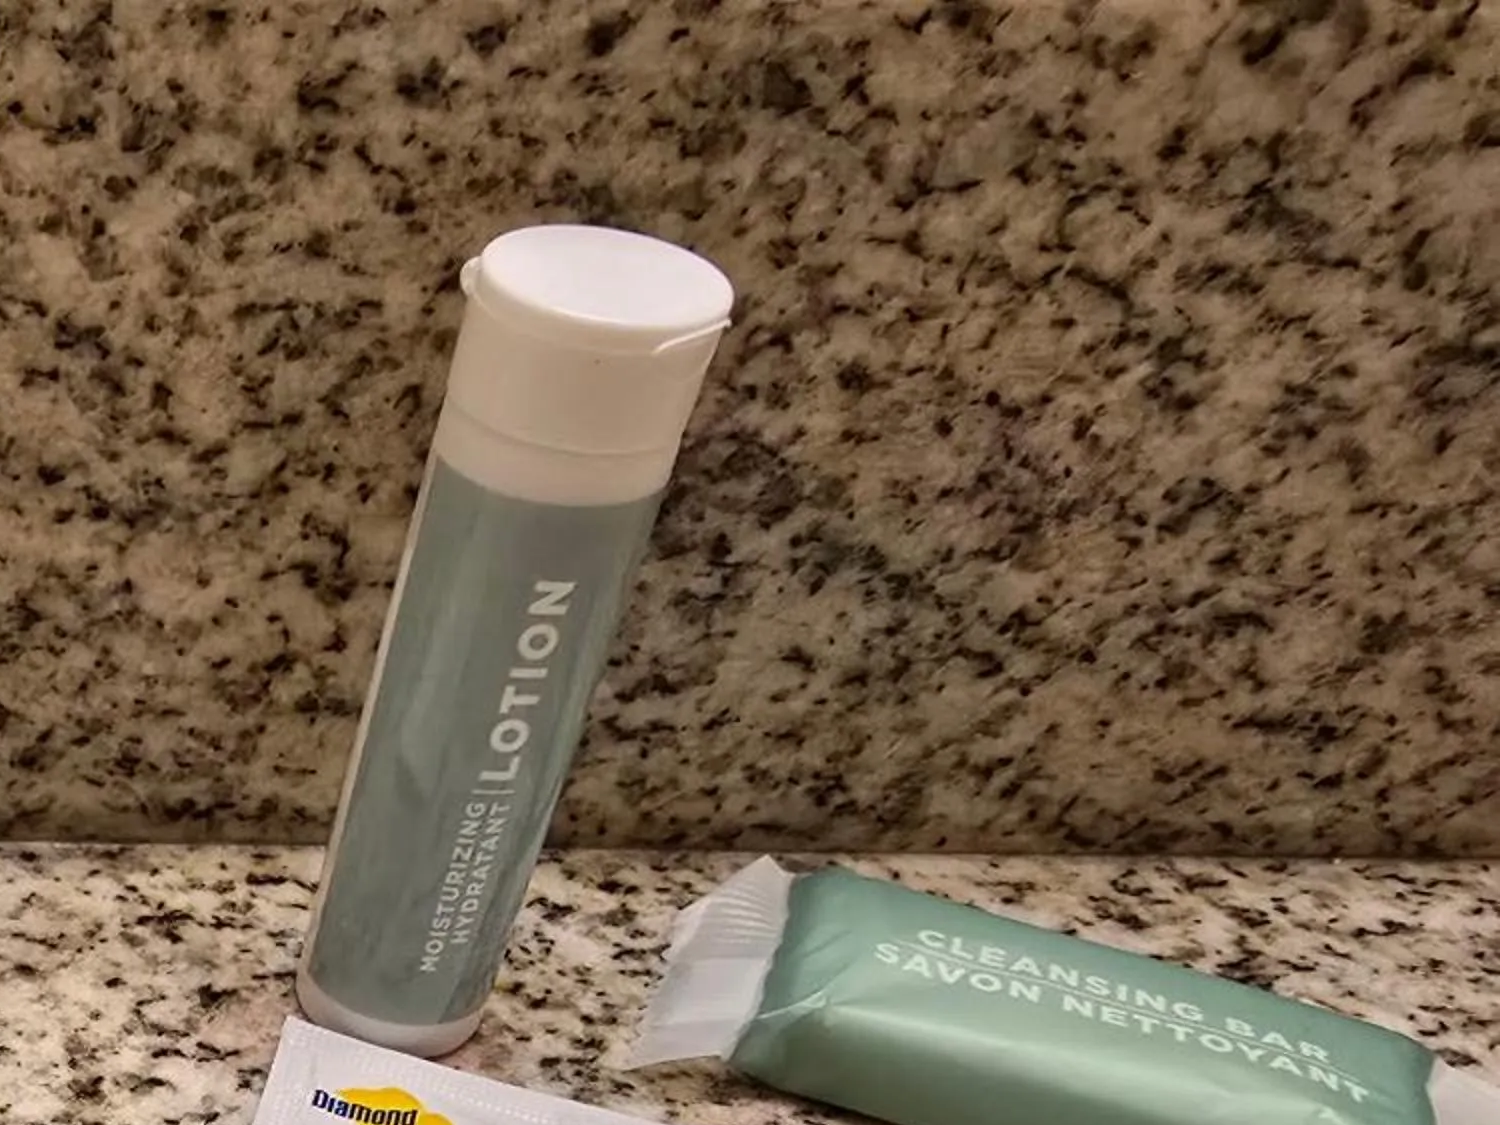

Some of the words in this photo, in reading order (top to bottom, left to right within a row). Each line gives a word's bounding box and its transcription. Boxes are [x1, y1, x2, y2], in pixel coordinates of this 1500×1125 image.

[480, 580, 577, 782] LOTION
[419, 801, 486, 973] MOISTURIZING
[453, 802, 511, 946] HYDRATANT
[874, 942, 1040, 1004] SAVON
[1062, 994, 1370, 1104] NETTOYANT
[917, 928, 1205, 1023] CLEANSING
[1223, 1016, 1331, 1064] BAR
